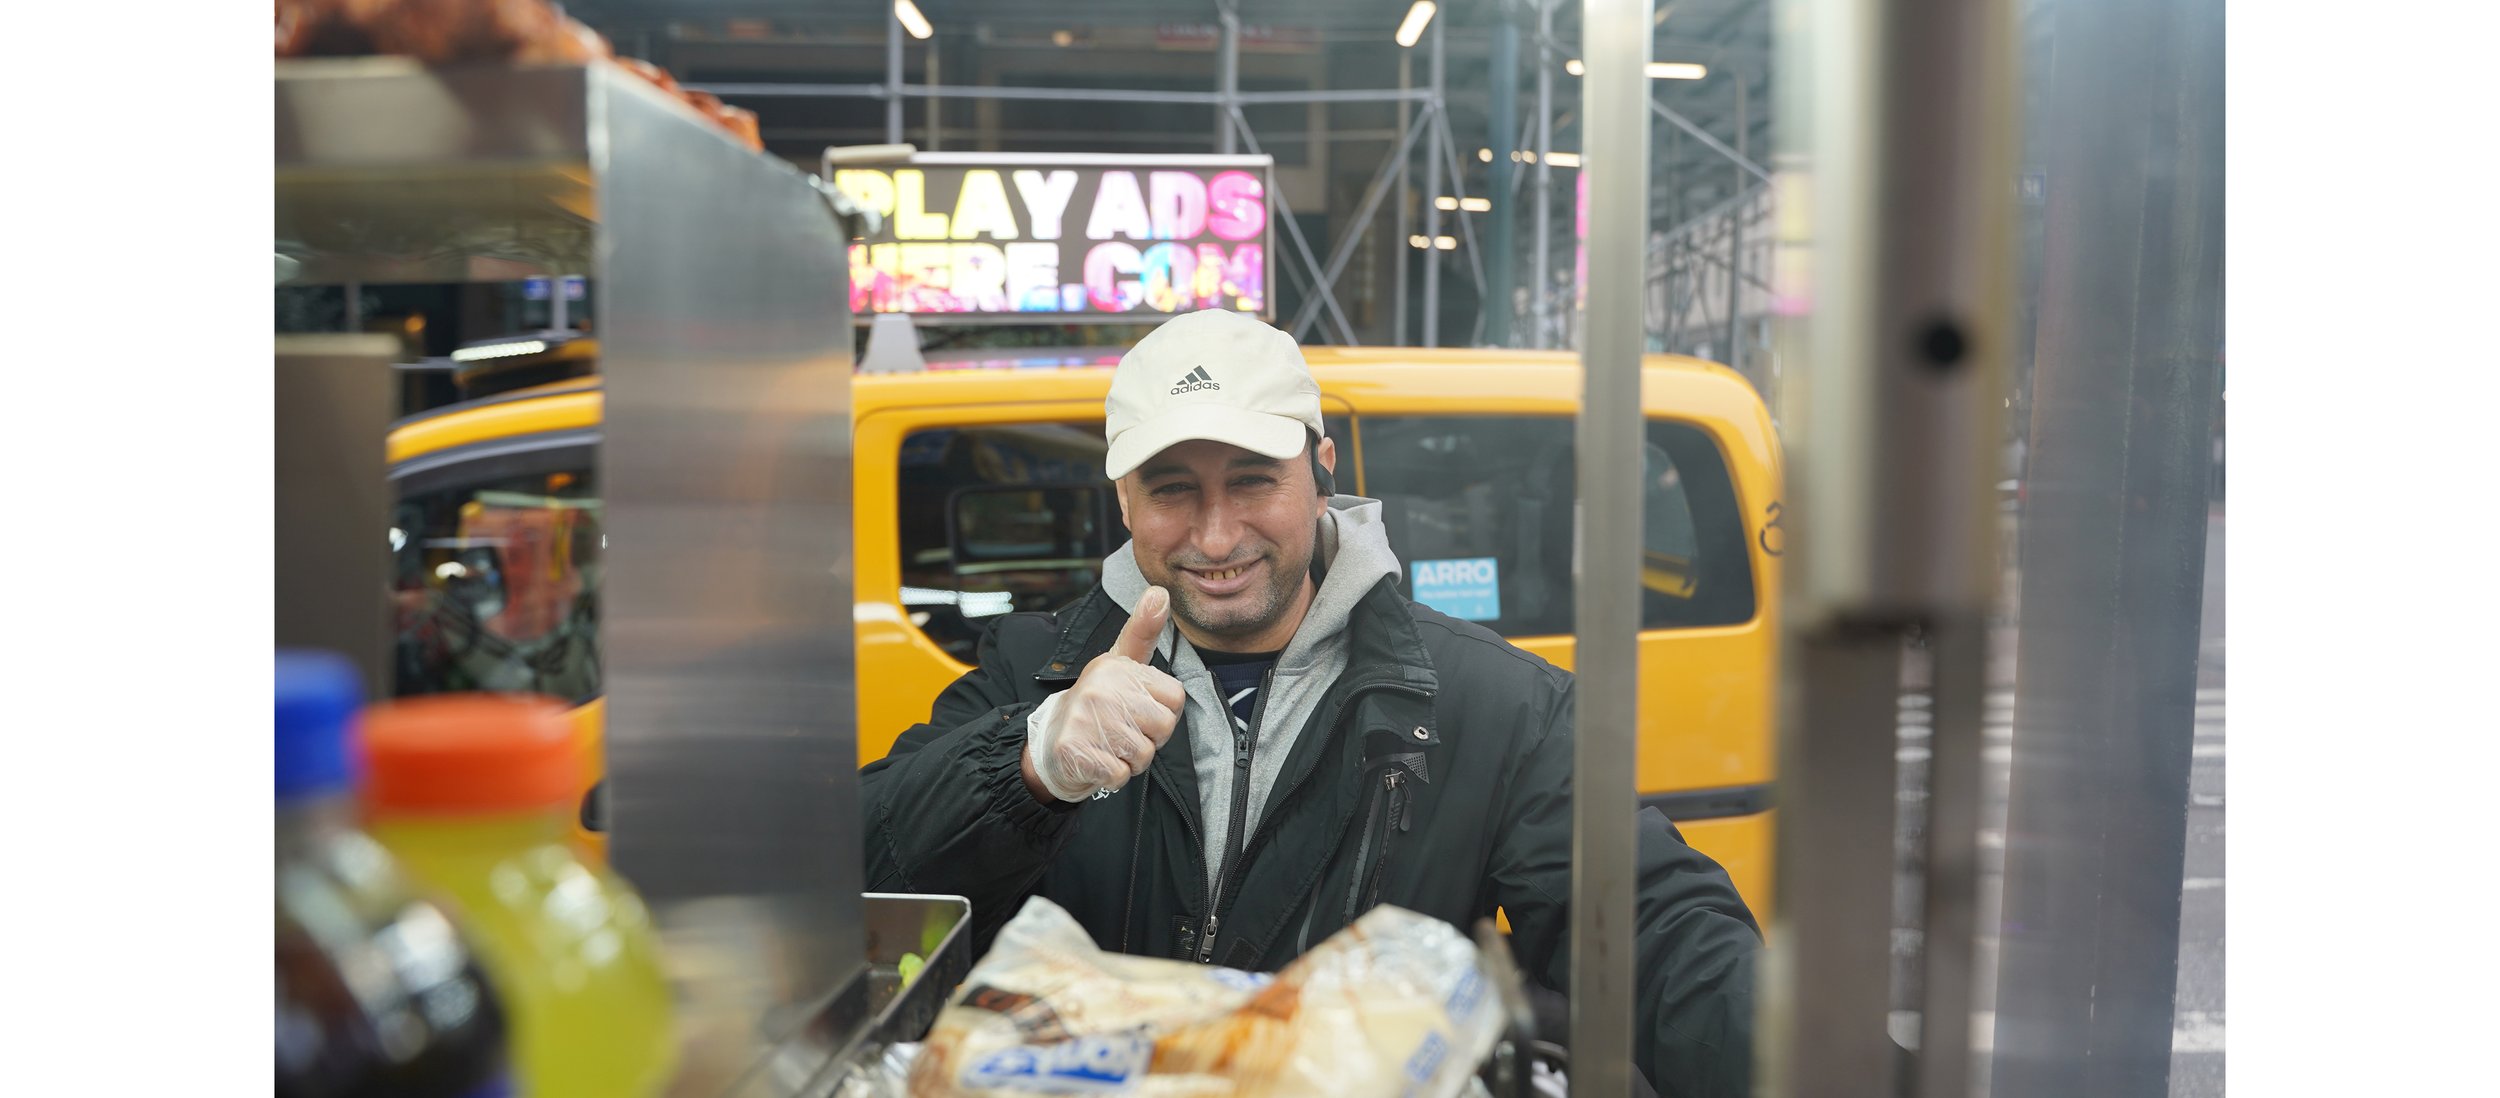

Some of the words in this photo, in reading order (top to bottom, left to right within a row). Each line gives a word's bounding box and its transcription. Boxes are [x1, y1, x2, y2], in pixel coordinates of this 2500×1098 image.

[835, 169, 1078, 240] PLAY
[1086, 170, 1266, 241] ADS
[1170, 381, 1221, 395] adidas
[1416, 560, 1495, 586] ARRO
